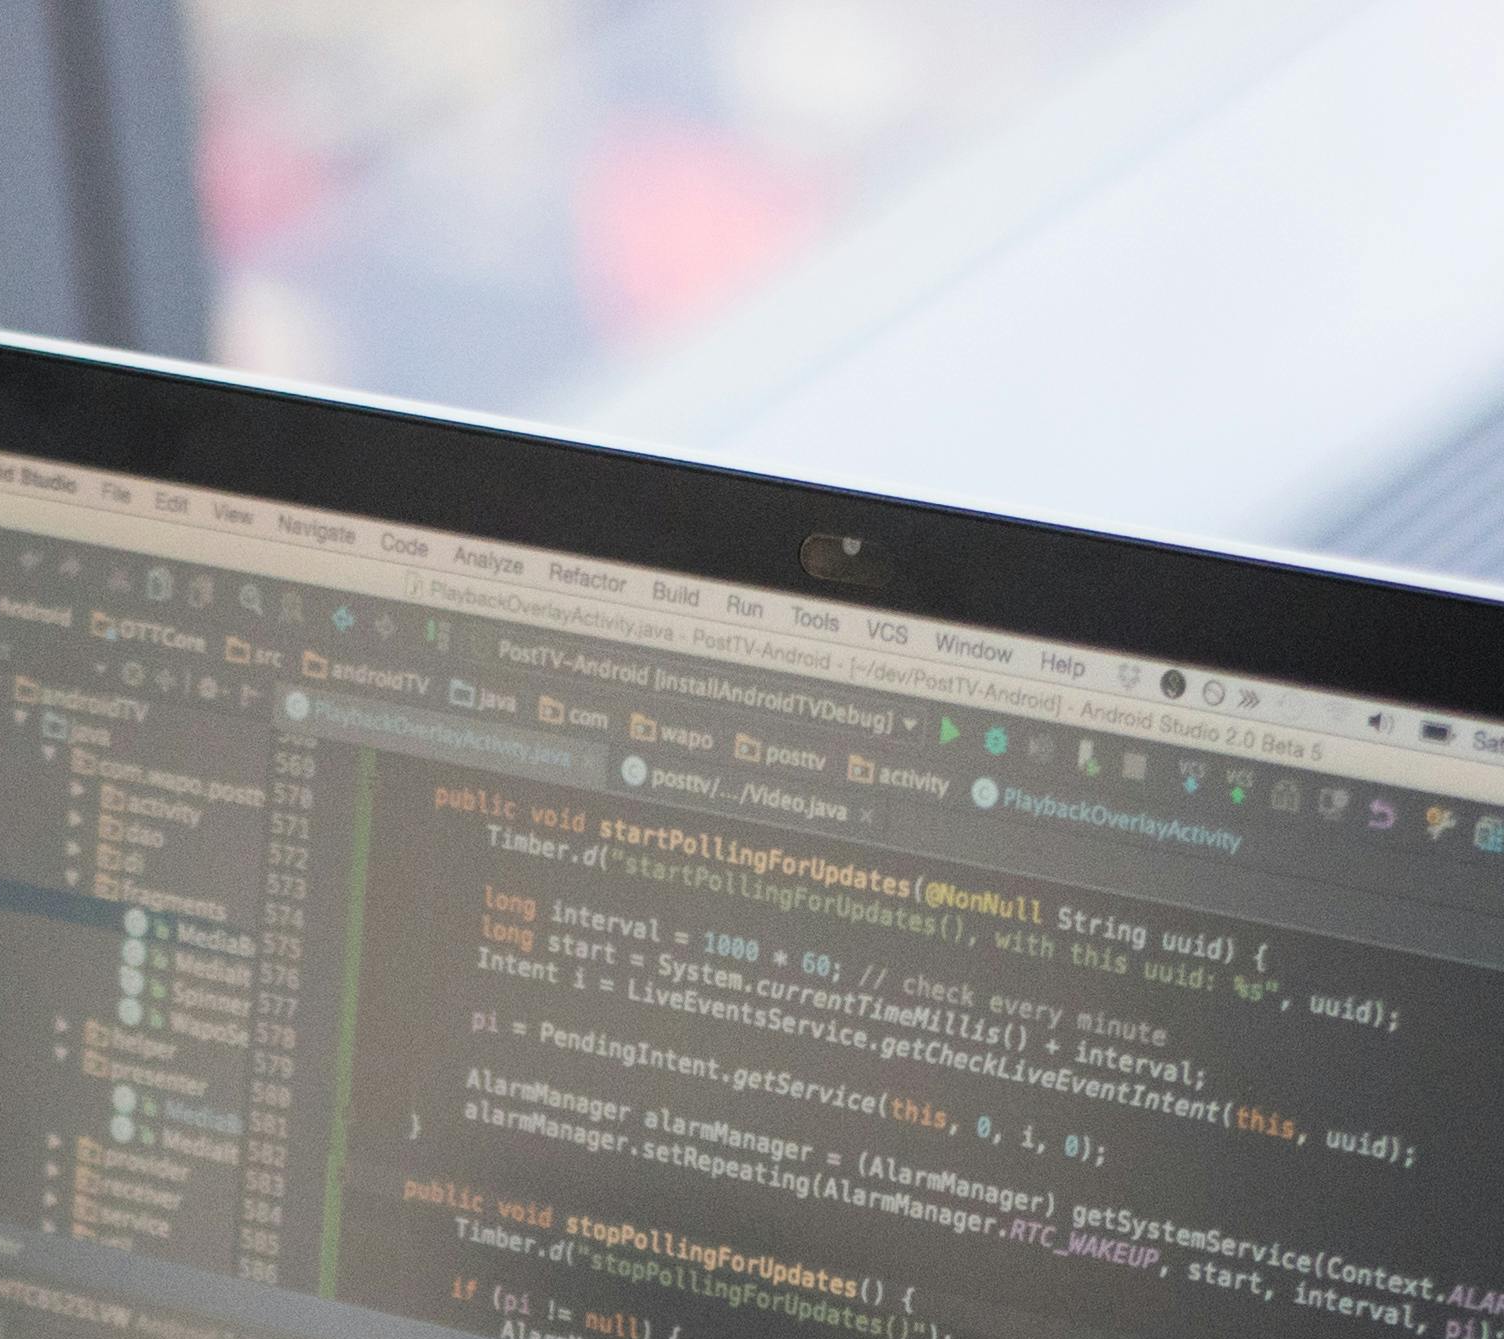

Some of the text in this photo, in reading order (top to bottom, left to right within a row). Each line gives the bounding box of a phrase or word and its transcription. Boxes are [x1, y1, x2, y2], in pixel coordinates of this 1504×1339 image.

[100, 481, 1086, 682] File Edit View Navigate Code Analyze Refactor Build Run Tools VCS Window Help
[331, 664, 430, 696] androidTV
[476, 687, 517, 714] java
[569, 710, 608, 731] com
[660, 727, 713, 752] wapo
[691, 629, 830, 672] PostTV-Android
[1080, 702, 1154, 731] Android
[1158, 716, 1217, 743] Studio
[1224, 728, 1255, 750] 2.0
[1260, 734, 1305, 760] Beta
[764, 747, 826, 772] posttv
[879, 769, 950, 800] activity
[1002, 788, 1242, 856] PlaybackOverlayActivity
[435, 788, 1232, 966] public void startPollingForUpdates(@NonNull String uuid)
[487, 824, 1396, 1032] Timber.d("startPollingForUpdates(), with this uuid: %s", uuid);
[481, 915, 1203, 1091] long start System.currentTimeMillis() interval;
[484, 885, 1166, 1047] long interval 1000 60; check every minute
[478, 946, 1413, 1167] Intent LiveEventsService.getCheckLiveEventIntent(this, uuid);
[541, 1021, 957, 1135] PendingIntent.getService(this,
[466, 1068, 632, 1122] AlarmManager
[645, 1108, 814, 1161] alarmManager
[859, 1152, 1054, 1219] (AlarmManager)
[404, 1179, 883, 1306] public void stopPollingForUpdates()
[465, 1099, 1424, 1333] alarmManager.setRepeating(AlarmManager.RTC_WAKEUP, start, interval,
[451, 1276, 477, 1301] if
